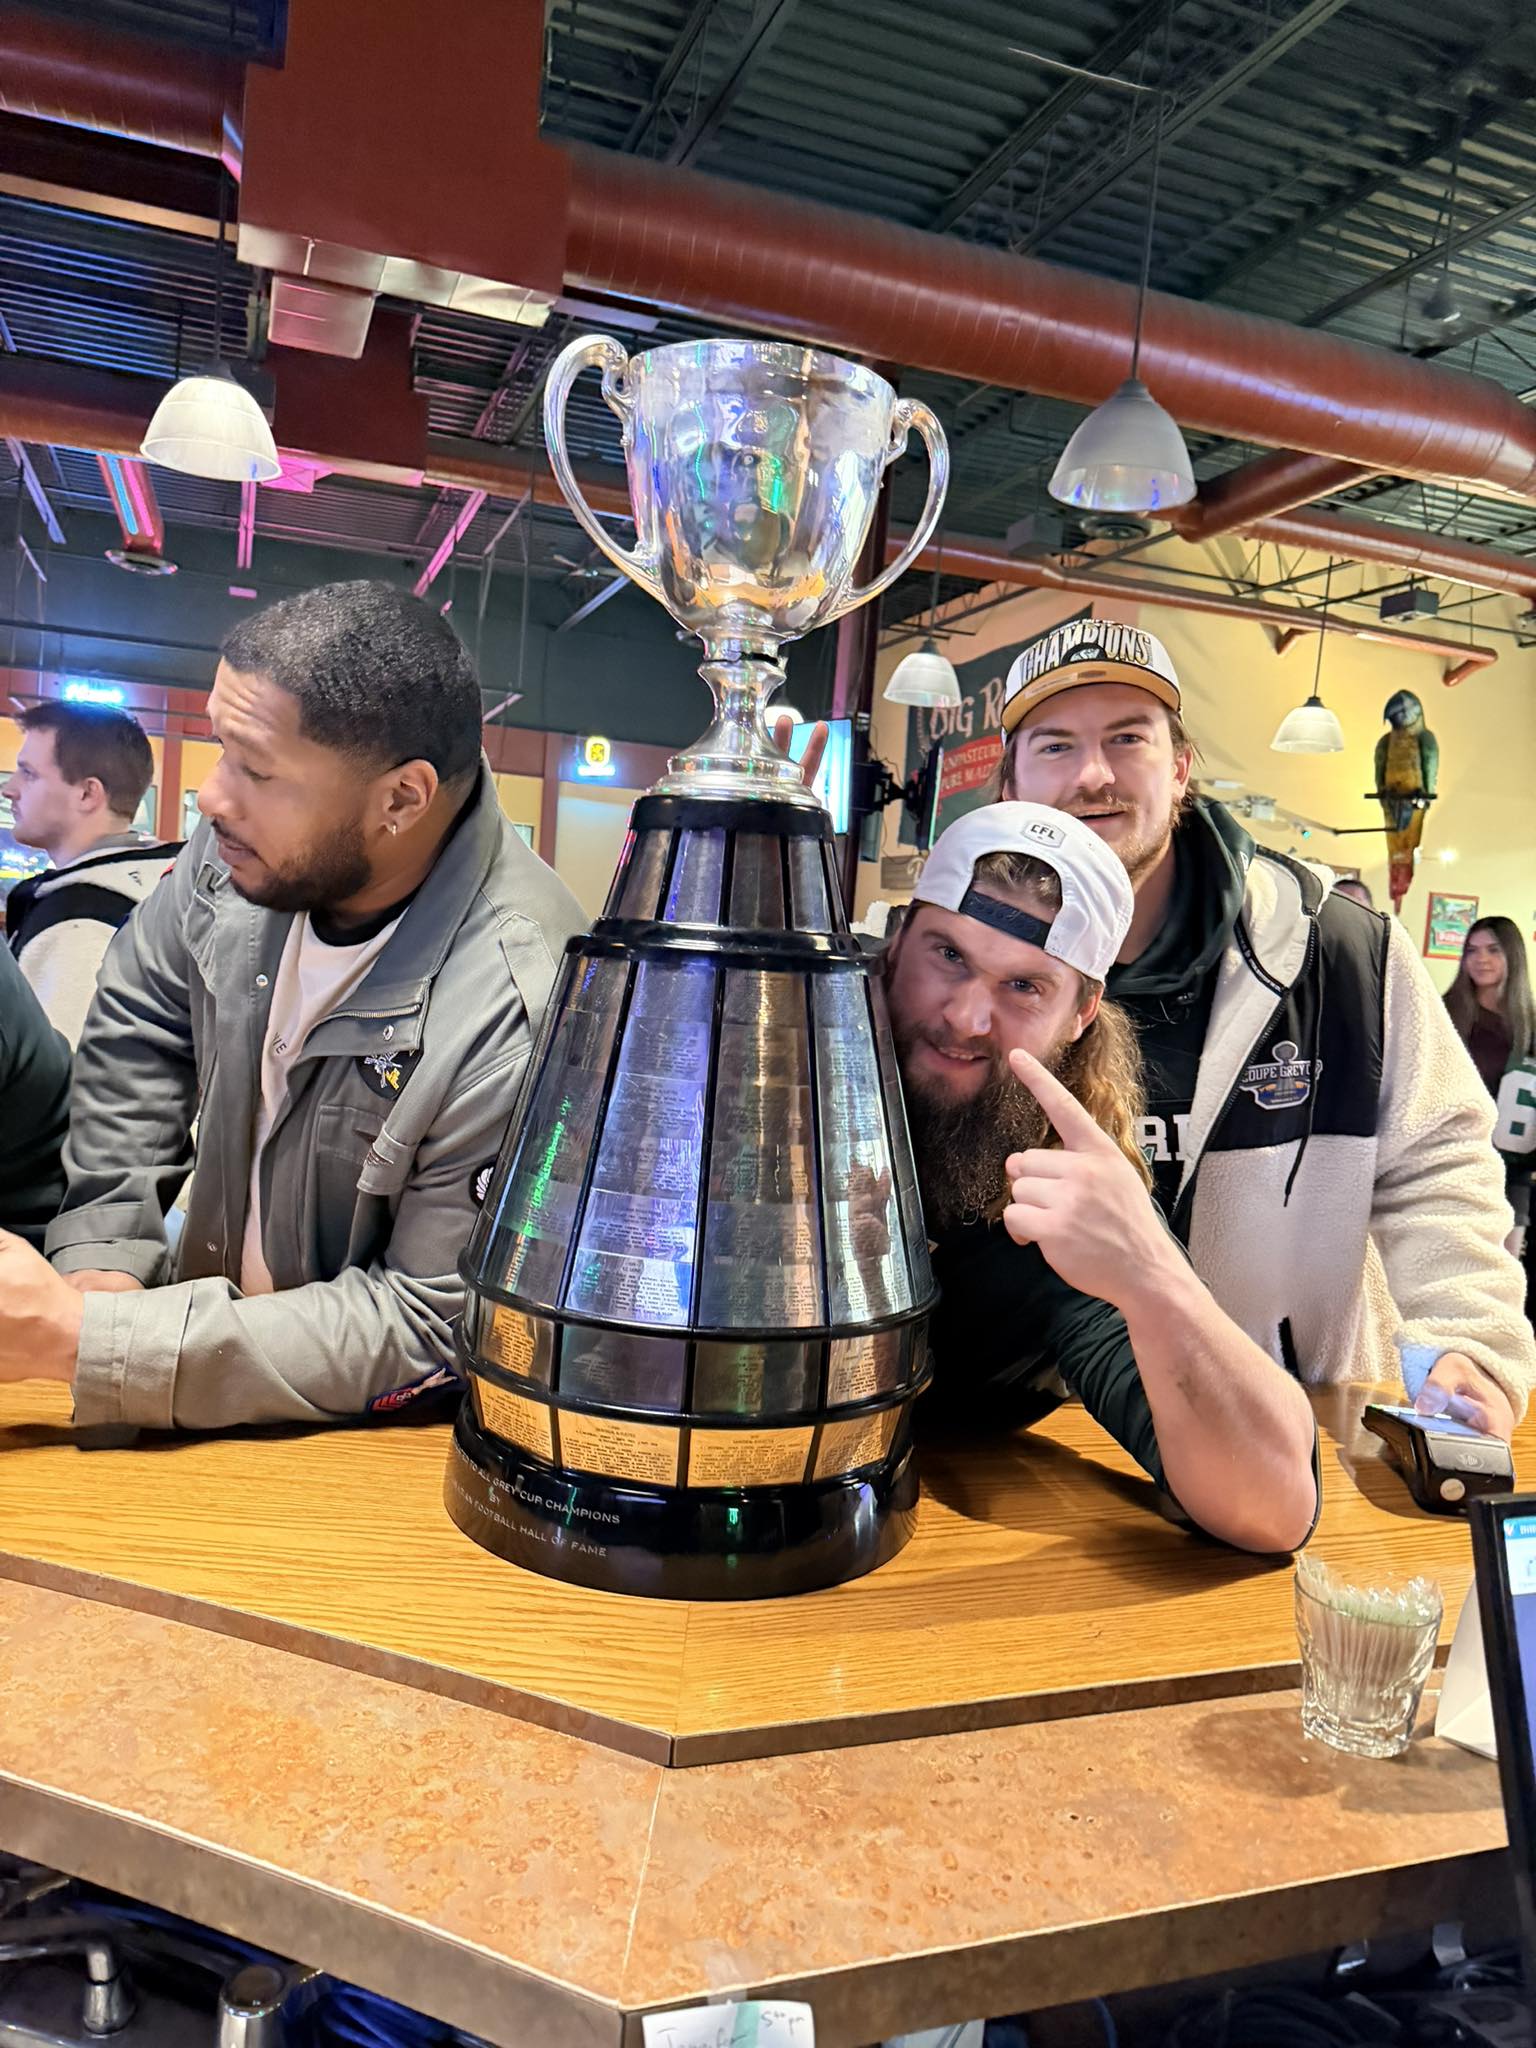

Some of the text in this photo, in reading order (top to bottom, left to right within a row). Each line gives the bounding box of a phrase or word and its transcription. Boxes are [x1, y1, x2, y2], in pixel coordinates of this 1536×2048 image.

[1020, 622, 1154, 686] CHAMPIONS
[1030, 824, 1055, 840] CFL
[1280, 1063, 1305, 1078] GREY
[492, 1476, 517, 1496] GREY
[519, 1490, 544, 1505] CUP
[545, 1499, 621, 1525] CHAMPIONS
[474, 1499, 518, 1531] FOOTBALL
[519, 1525, 547, 1542] HALL
[551, 1535, 567, 1548] OF
[570, 1541, 607, 1558] FAME
